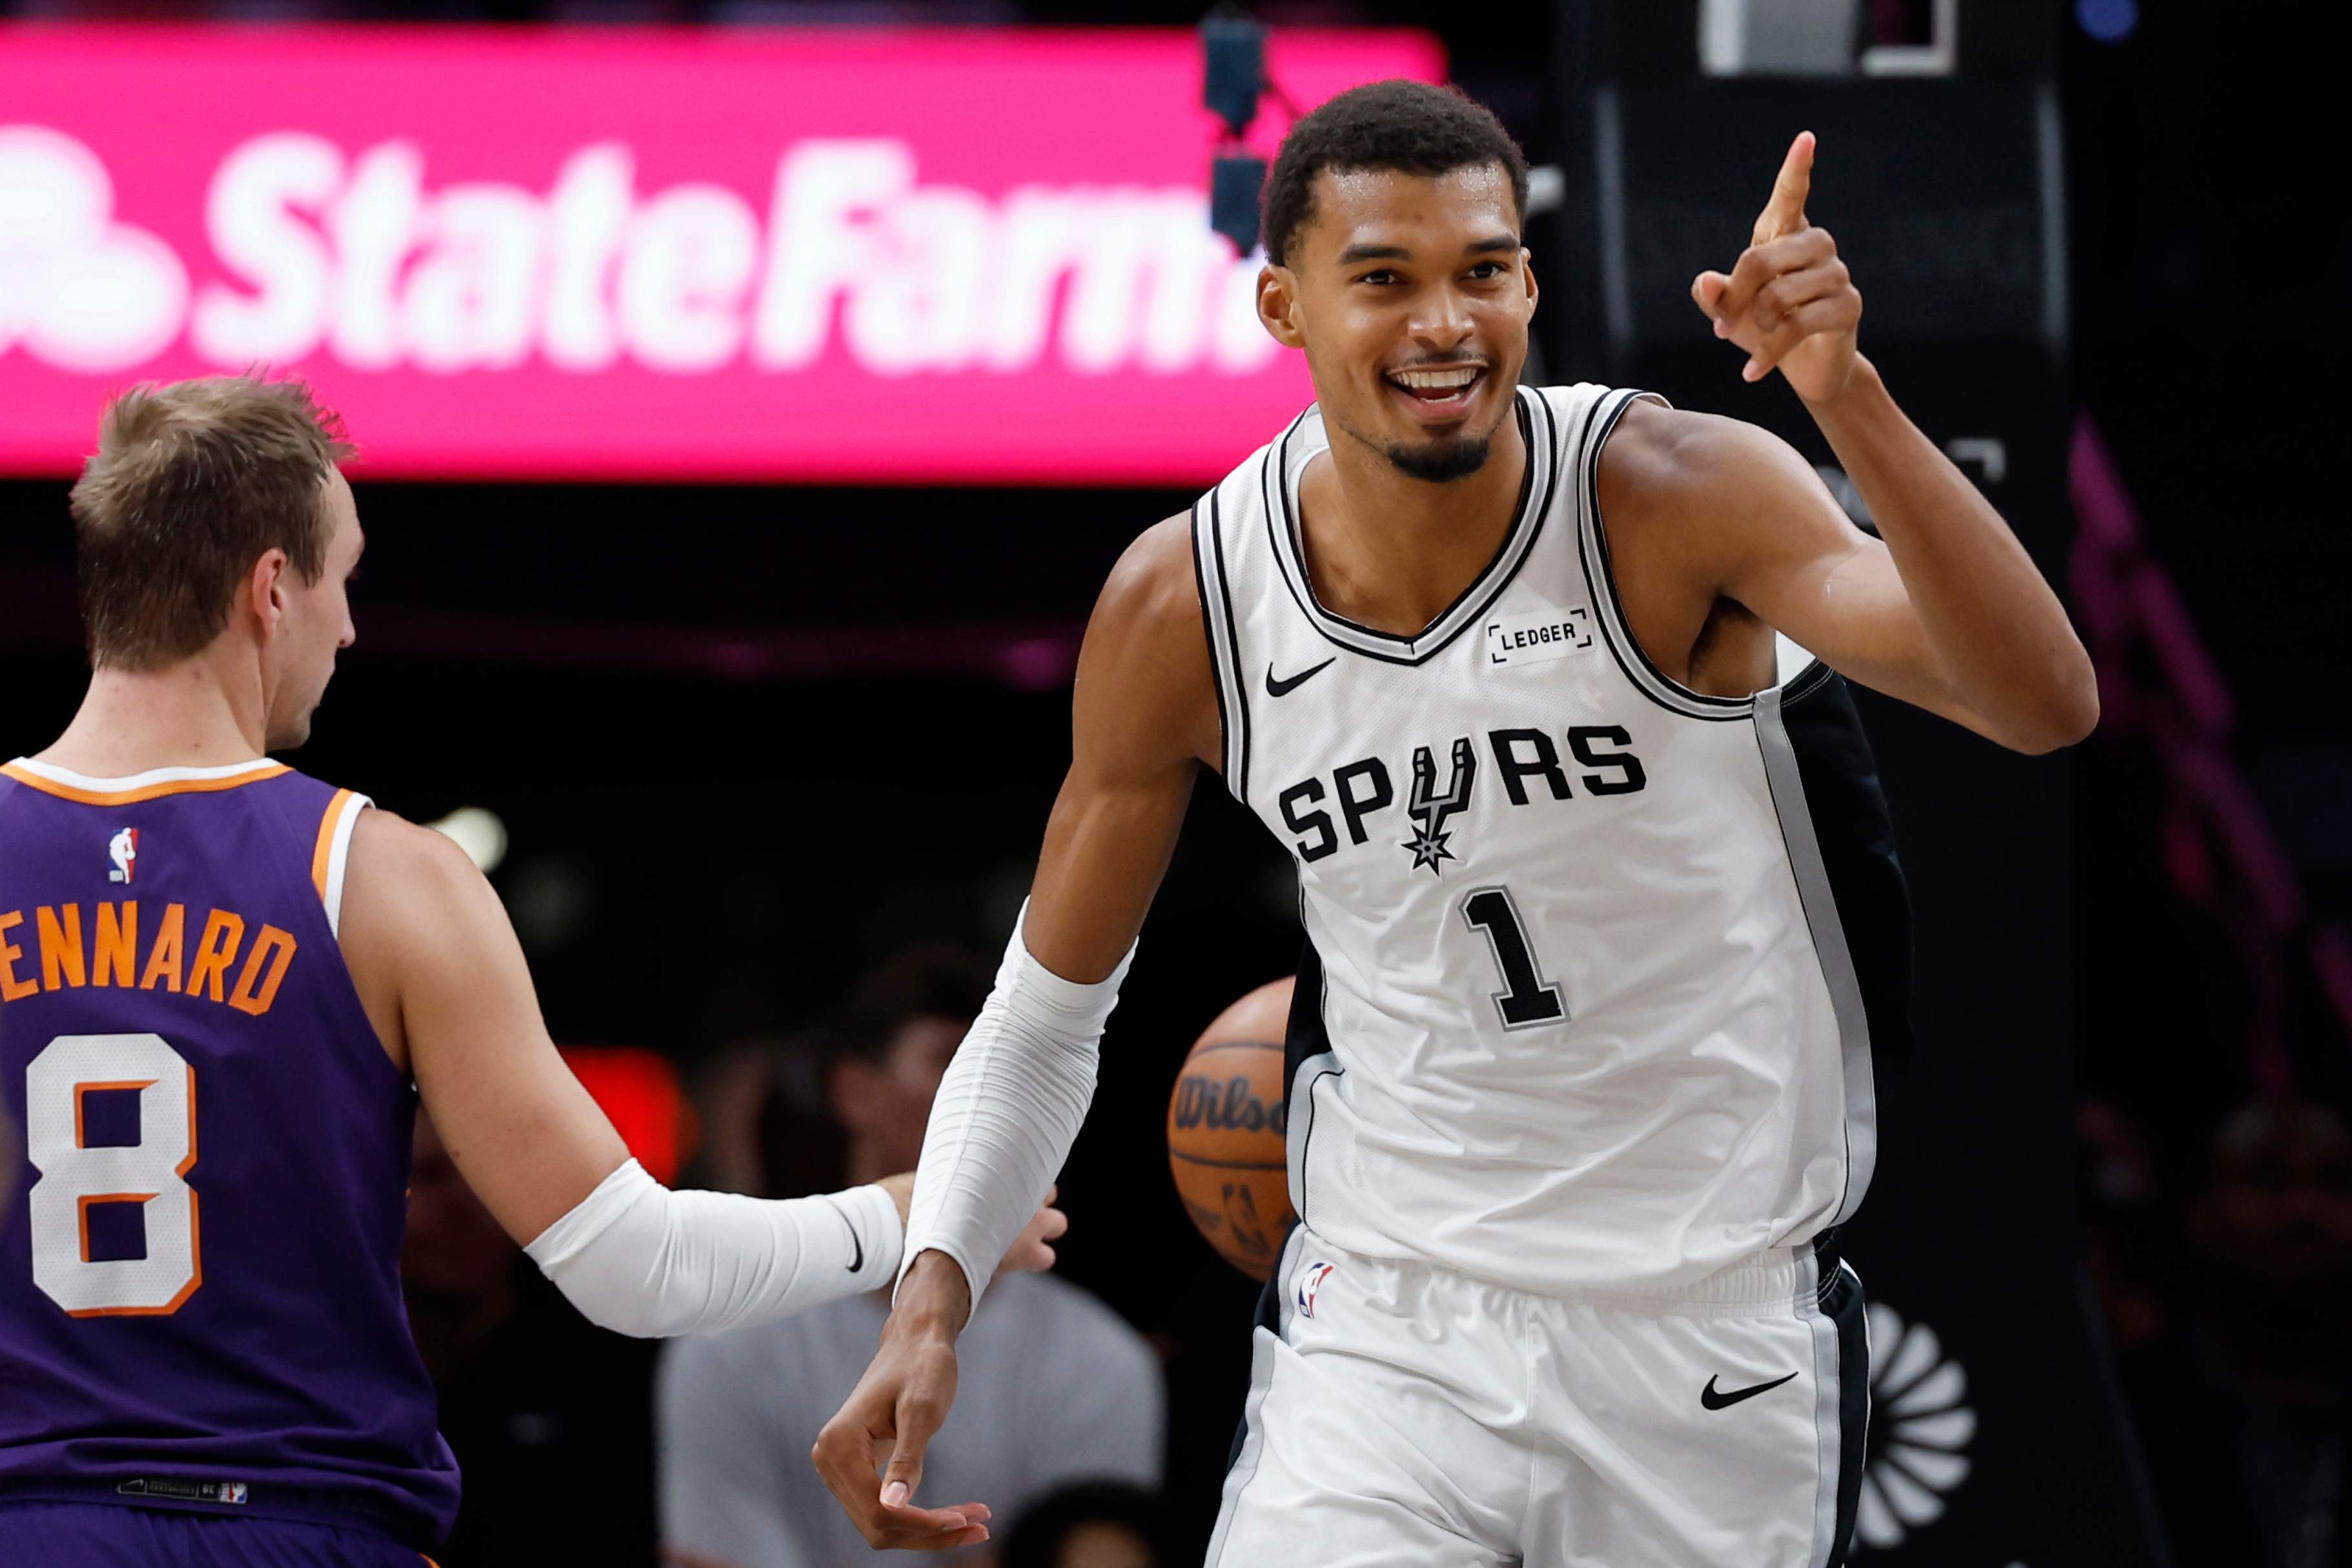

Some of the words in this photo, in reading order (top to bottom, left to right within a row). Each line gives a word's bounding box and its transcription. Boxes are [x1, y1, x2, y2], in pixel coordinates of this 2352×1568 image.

[1501, 622, 1576, 651] LEDGER
[1278, 725, 1647, 877] SPURS
[1459, 884, 1571, 1031] 1
[26, 1033, 202, 1318] 8
